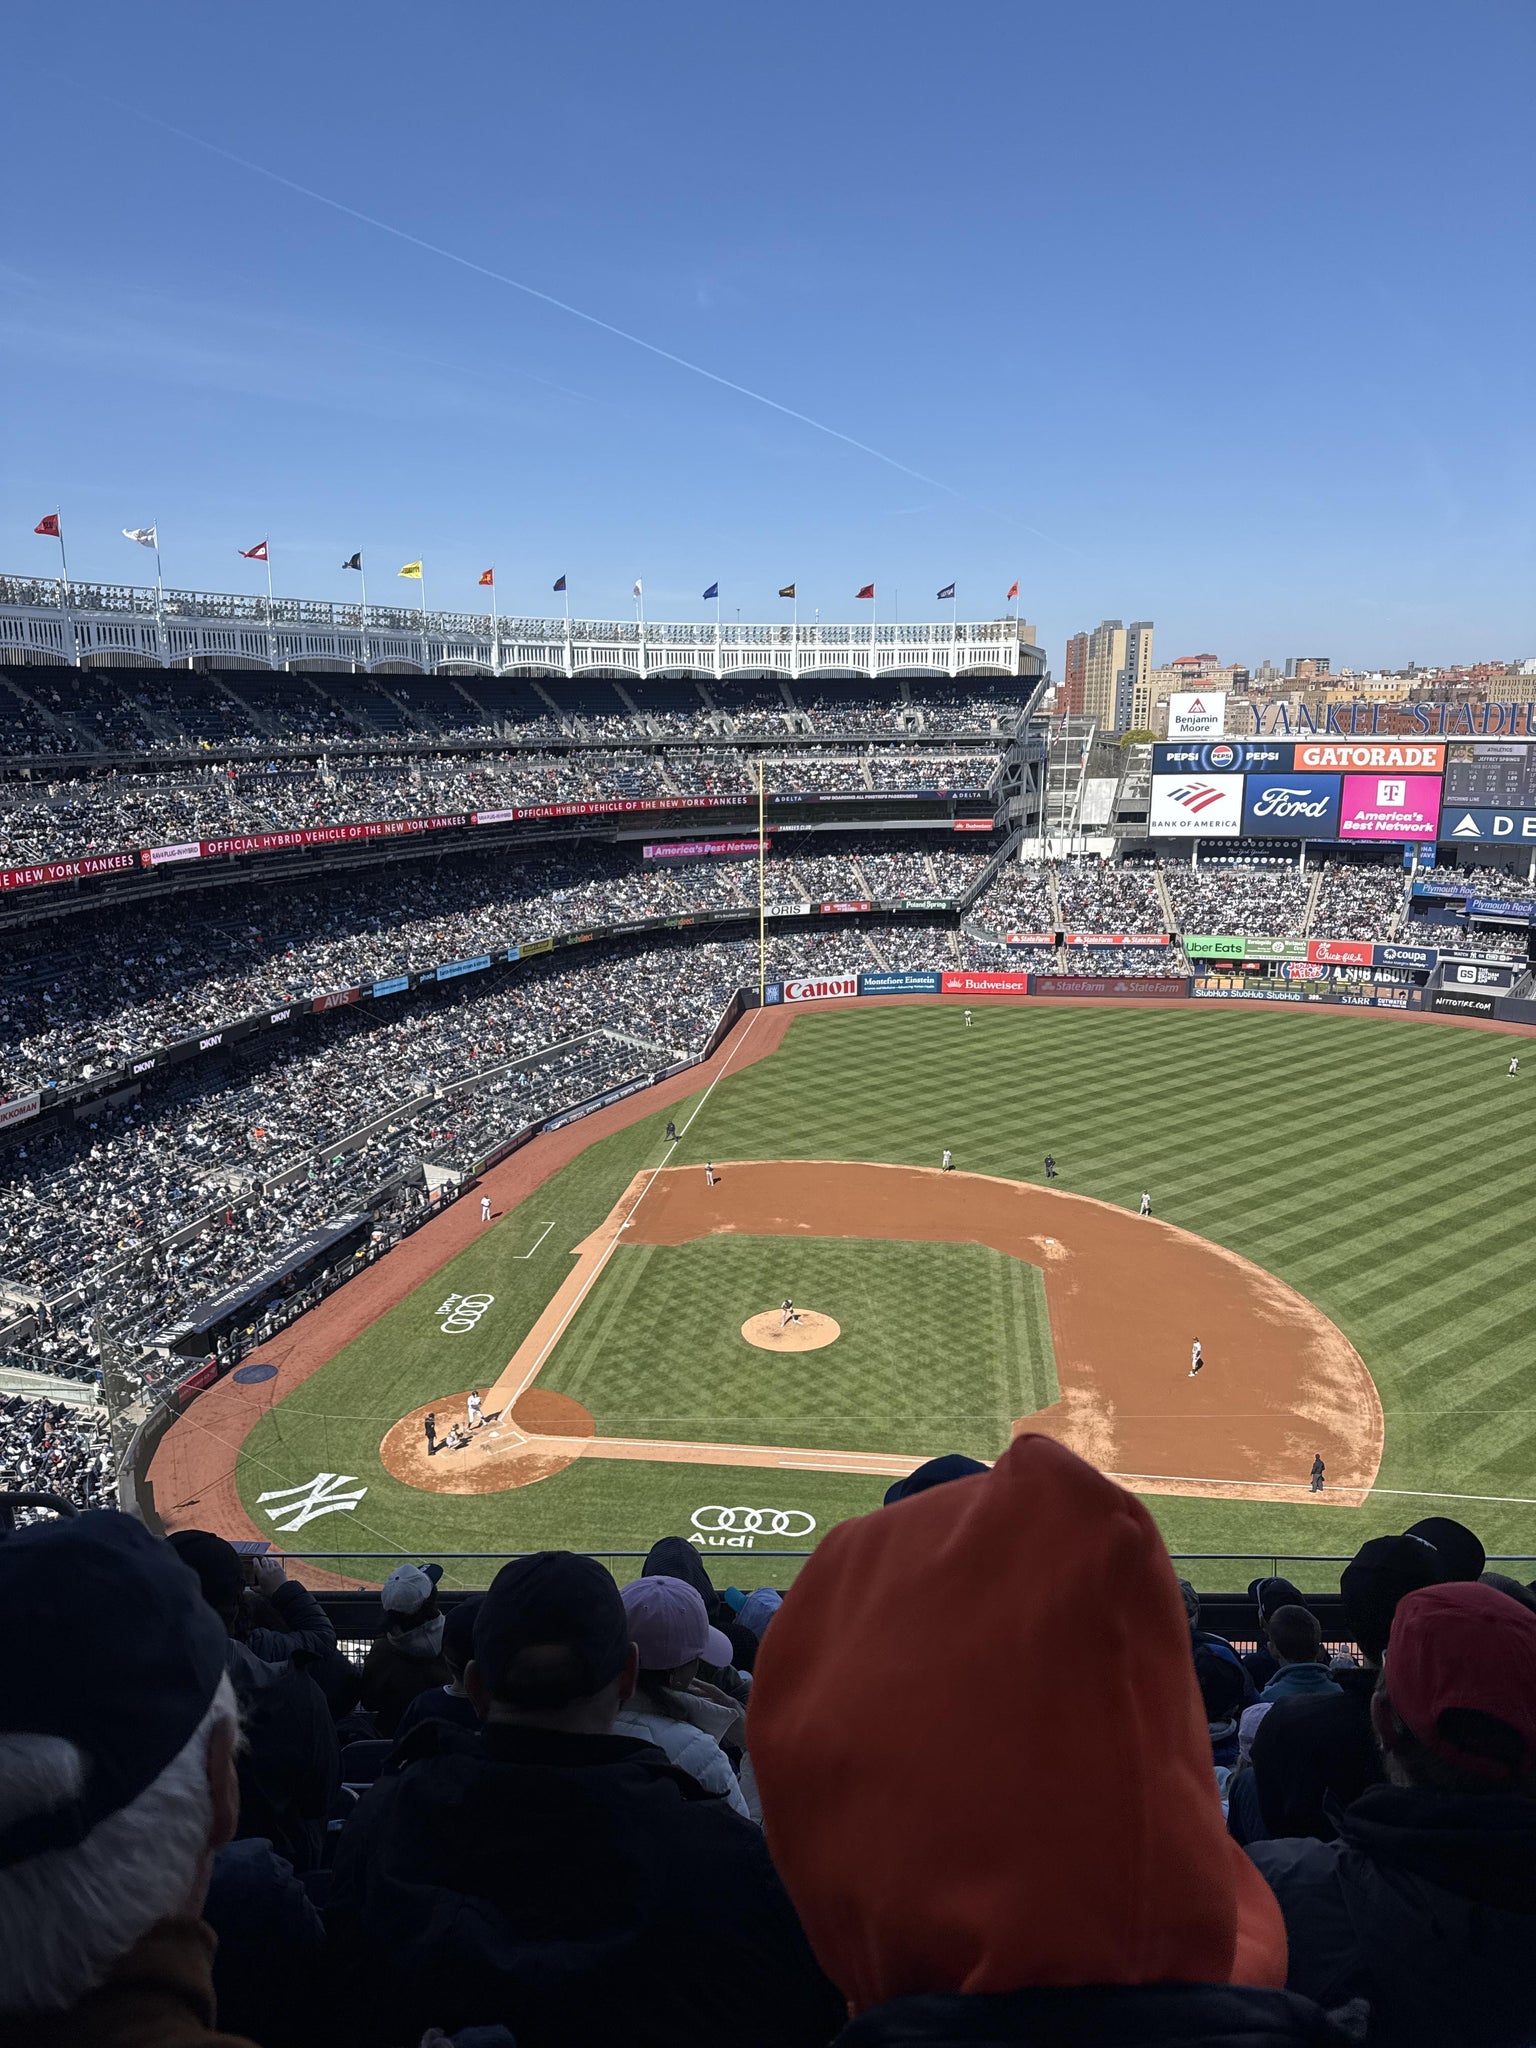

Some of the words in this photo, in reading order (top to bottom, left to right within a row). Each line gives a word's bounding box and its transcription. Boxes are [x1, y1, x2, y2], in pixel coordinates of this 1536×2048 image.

[1175, 716, 1218, 725] Benjamin
[1251, 703, 1390, 734] YANKEE
[1180, 724, 1210, 732] Moore
[1166, 753, 1198, 761] PEPSI
[1246, 752, 1279, 760] PEPSI
[1303, 748, 1436, 766] GATORADE
[245, 777, 272, 785] ASPEN
[518, 808, 553, 818] OFFICIAL
[556, 805, 586, 814] HYBRID
[589, 804, 622, 812] VEHICLE
[626, 802, 637, 810] OF
[640, 801, 656, 809] THE
[660, 800, 678, 808] NEW
[682, 798, 705, 806] YORK
[709, 797, 747, 805] YANKEES
[1254, 788, 1330, 817] Ford
[1354, 811, 1423, 822] America's
[1343, 820, 1373, 830] Best
[1375, 821, 1434, 832] Network
[208, 839, 259, 853] OFFICIAL
[263, 833, 301, 846] HYBRID
[305, 828, 346, 842] VEHICLE
[350, 826, 362, 836] OF
[365, 824, 381, 835] THE
[384, 821, 404, 832] NEW
[407, 818, 428, 830] YORK
[431, 816, 466, 828] YANKEES
[655, 844, 703, 855] America's
[704, 844, 725, 852] Best
[727, 842, 768, 851] Netwok
[16, 869, 43, 884] NEW
[48, 862, 81, 879] YORK
[85, 855, 134, 872] YANKEES
[1422, 884, 1458, 894] Plymouth
[771, 905, 801, 915] ORIS
[928, 901, 946, 910] Spring
[1472, 900, 1510, 910] Plymouth
[1512, 902, 1533, 911] Rock
[1186, 943, 1212, 952] Uber
[1215, 943, 1242, 953] Eats
[1316, 945, 1363, 962] Chick-fil-A
[1397, 951, 1426, 962] coupa
[1333, 965, 1342, 979] A
[1346, 966, 1371, 982] SUB
[1374, 967, 1416, 983] ABOVE
[1460, 970, 1474, 978] GS
[864, 977, 903, 985] Montefiore
[905, 976, 935, 984] Einstein
[965, 979, 1023, 990] Budweiser
[785, 980, 855, 999] Canon
[324, 992, 349, 1008] AVIS
[1267, 992, 1300, 1000] StubHub
[1342, 997, 1370, 1005] STARR
[1436, 998, 1491, 1010] NITTOTIRE.COM
[271, 1009, 291, 1023] DKNY
[200, 1034, 222, 1050] DKNY
[134, 1059, 155, 1074] DKNY
[434, 1293, 462, 1314] Audi
[686, 1532, 754, 1548] Audi
